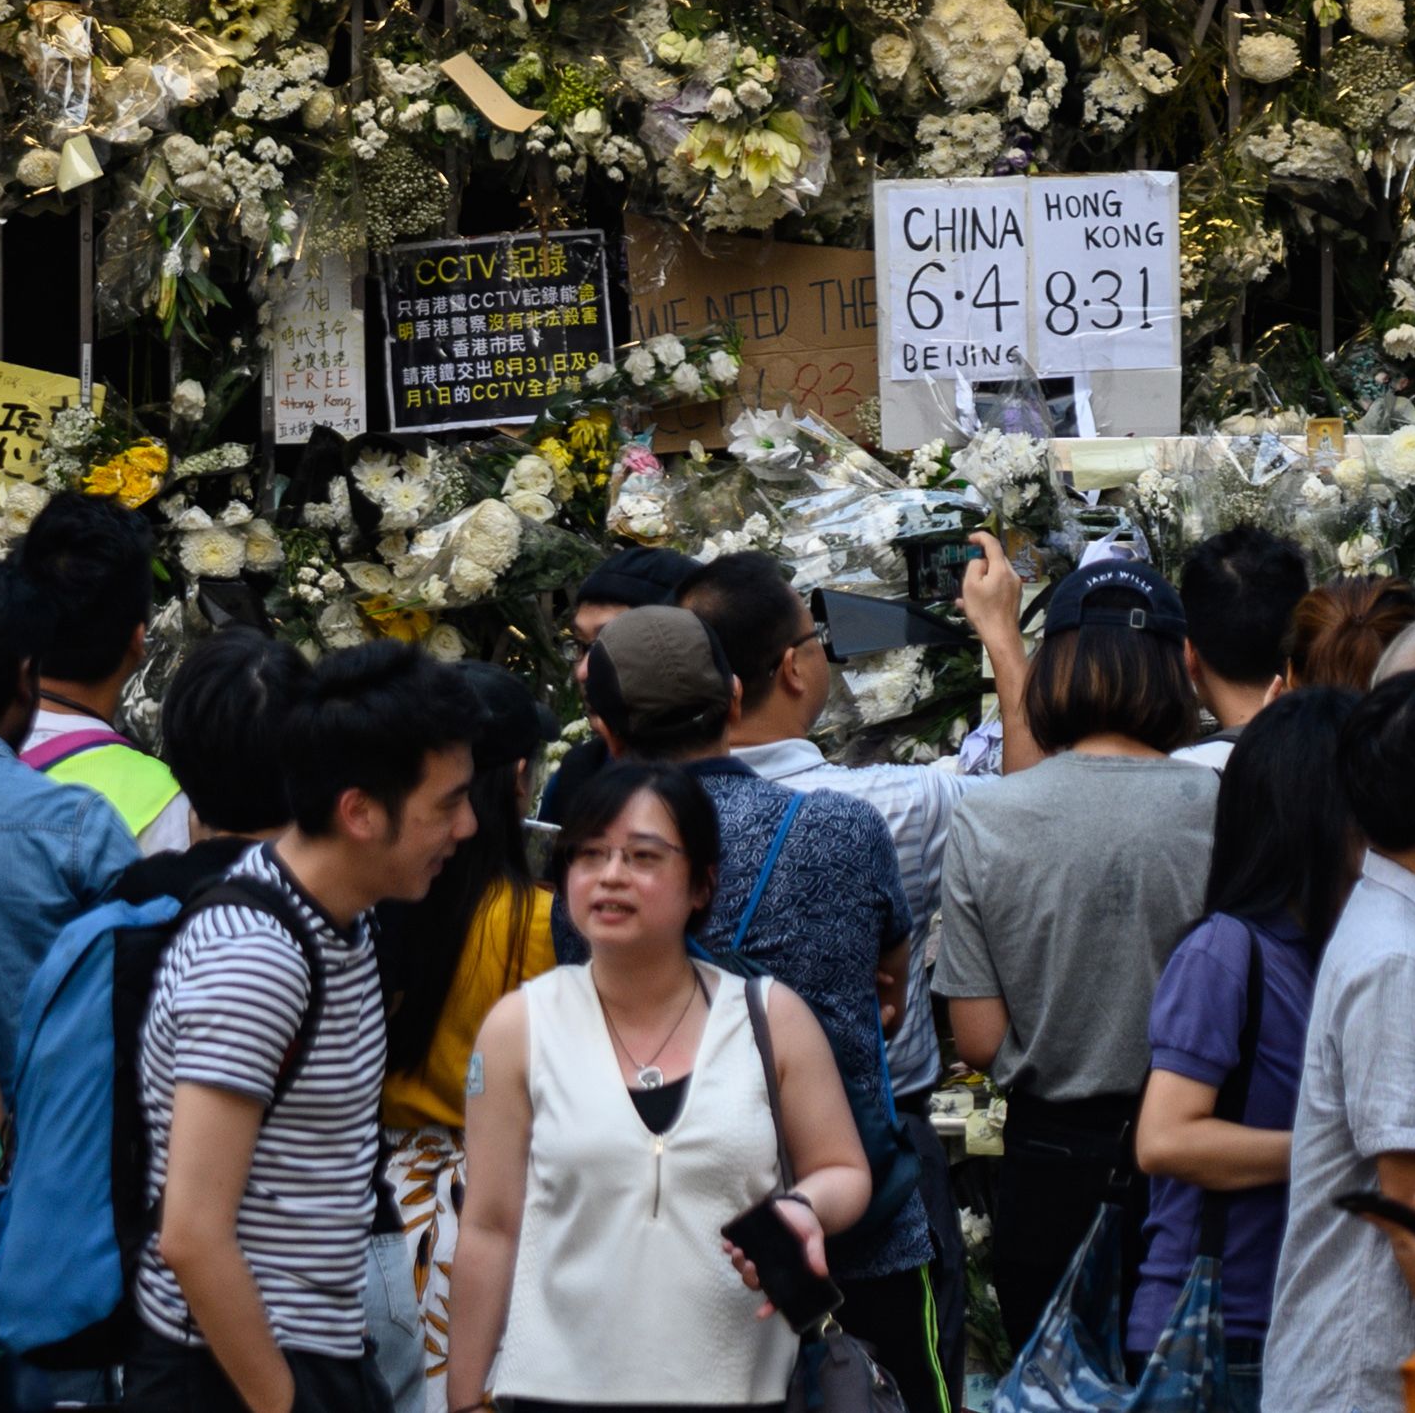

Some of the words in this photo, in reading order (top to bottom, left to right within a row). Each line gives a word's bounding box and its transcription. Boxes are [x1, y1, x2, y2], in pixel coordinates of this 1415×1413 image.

[1044, 189, 1124, 222] HONG
[903, 205, 1025, 253] CHINA
[1084, 220, 1165, 252] KONG
[415, 251, 498, 286] CCTV
[809, 275, 878, 335] THE
[452, 333, 527, 359] 香港市民
[902, 342, 1023, 374] BEIJING
[284, 369, 351, 391] FREE
[280, 395, 319, 416] Hong
[324, 393, 356, 417] Kong
[1086, 571, 1114, 588] JACK
[1119, 570, 1154, 593] WILLS
